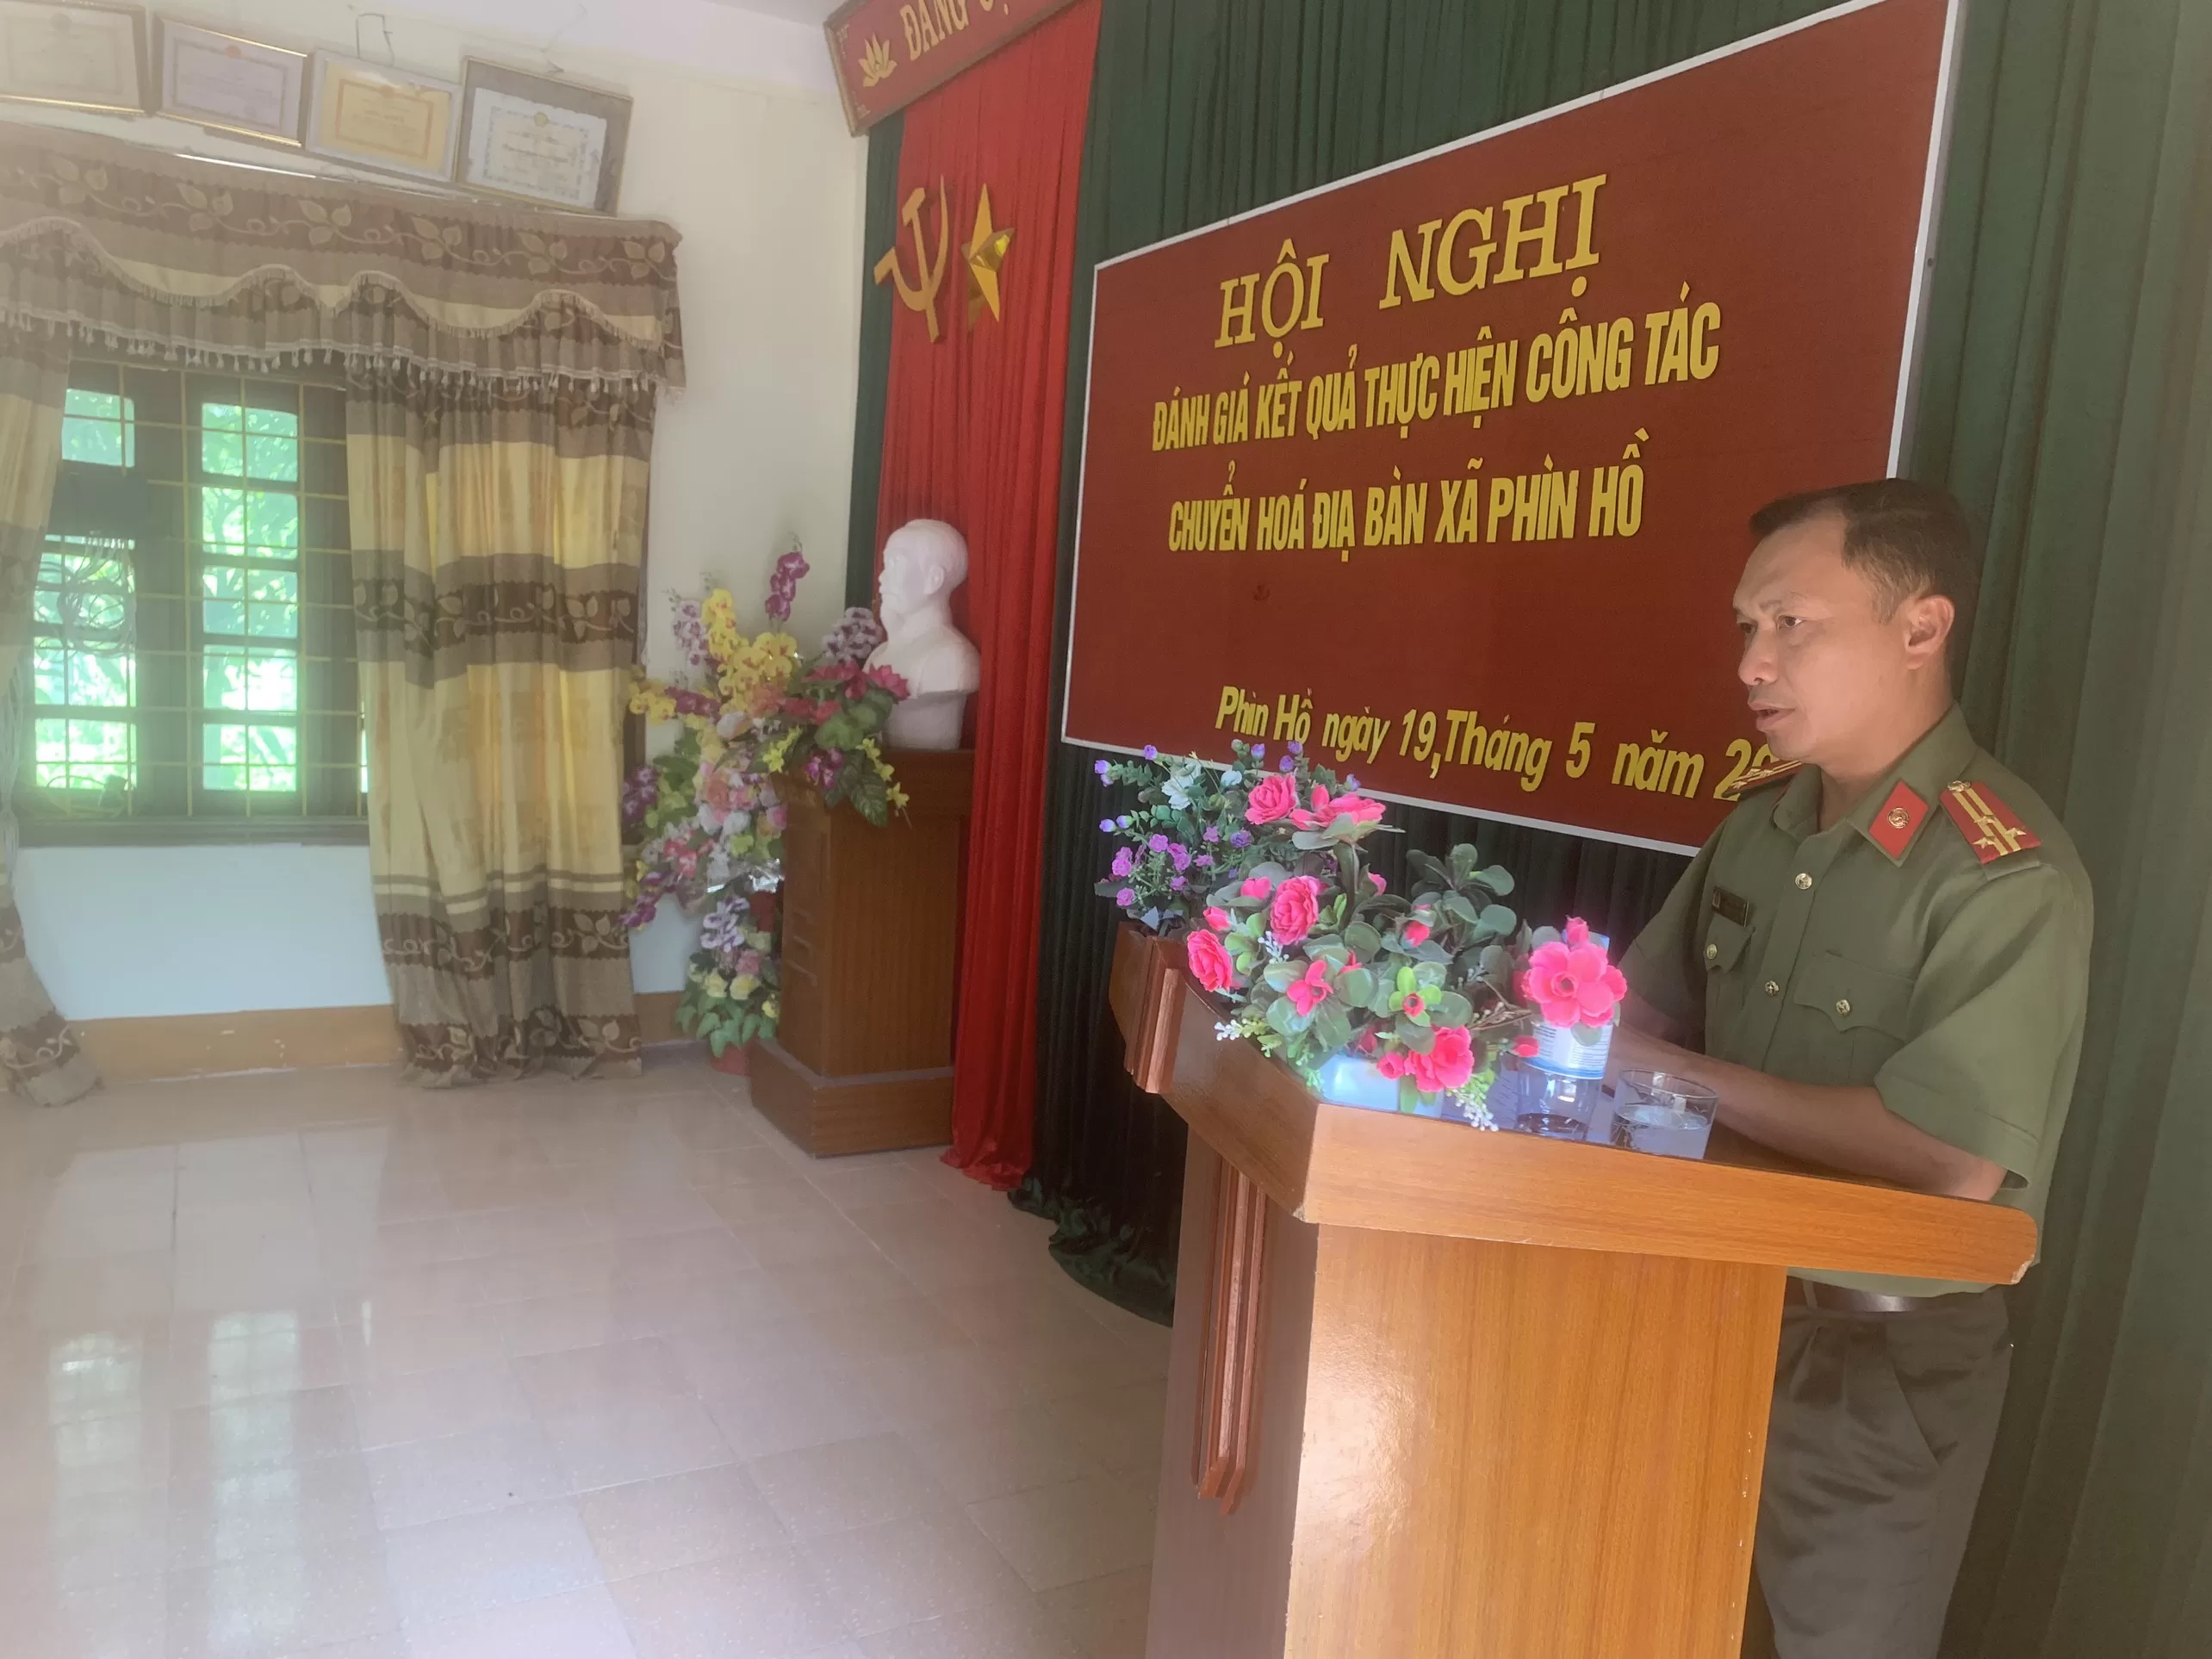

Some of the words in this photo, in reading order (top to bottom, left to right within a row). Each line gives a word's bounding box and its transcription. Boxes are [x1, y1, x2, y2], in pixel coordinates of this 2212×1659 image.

[1215, 239, 1329, 358] HỘI
[1379, 174, 1606, 309] NGHỊ
[1153, 387, 1209, 450] ĐÁNH
[1214, 371, 1249, 444] GIÁ
[1255, 351, 1302, 439] KẾT
[1307, 344, 1357, 439] QUẢ
[1364, 353, 1439, 438] THỰC
[1444, 326, 1518, 428] HIỆN
[1526, 308, 1633, 402] CÔNG
[1645, 282, 1720, 385] TÁC
[1169, 461, 1250, 551] CHUYỂN
[1257, 478, 1307, 551] HOÁ
[1364, 465, 1427, 545] BÀN
[1434, 457, 1483, 544] XÃ
[1487, 454, 1579, 542] PHÌN
[1588, 428, 1649, 536] HỒ
[1273, 687, 1313, 744] Hồ
[1321, 706, 1390, 764] ngày
[1567, 723, 1594, 778] 5
[1612, 730, 1704, 798] năm
